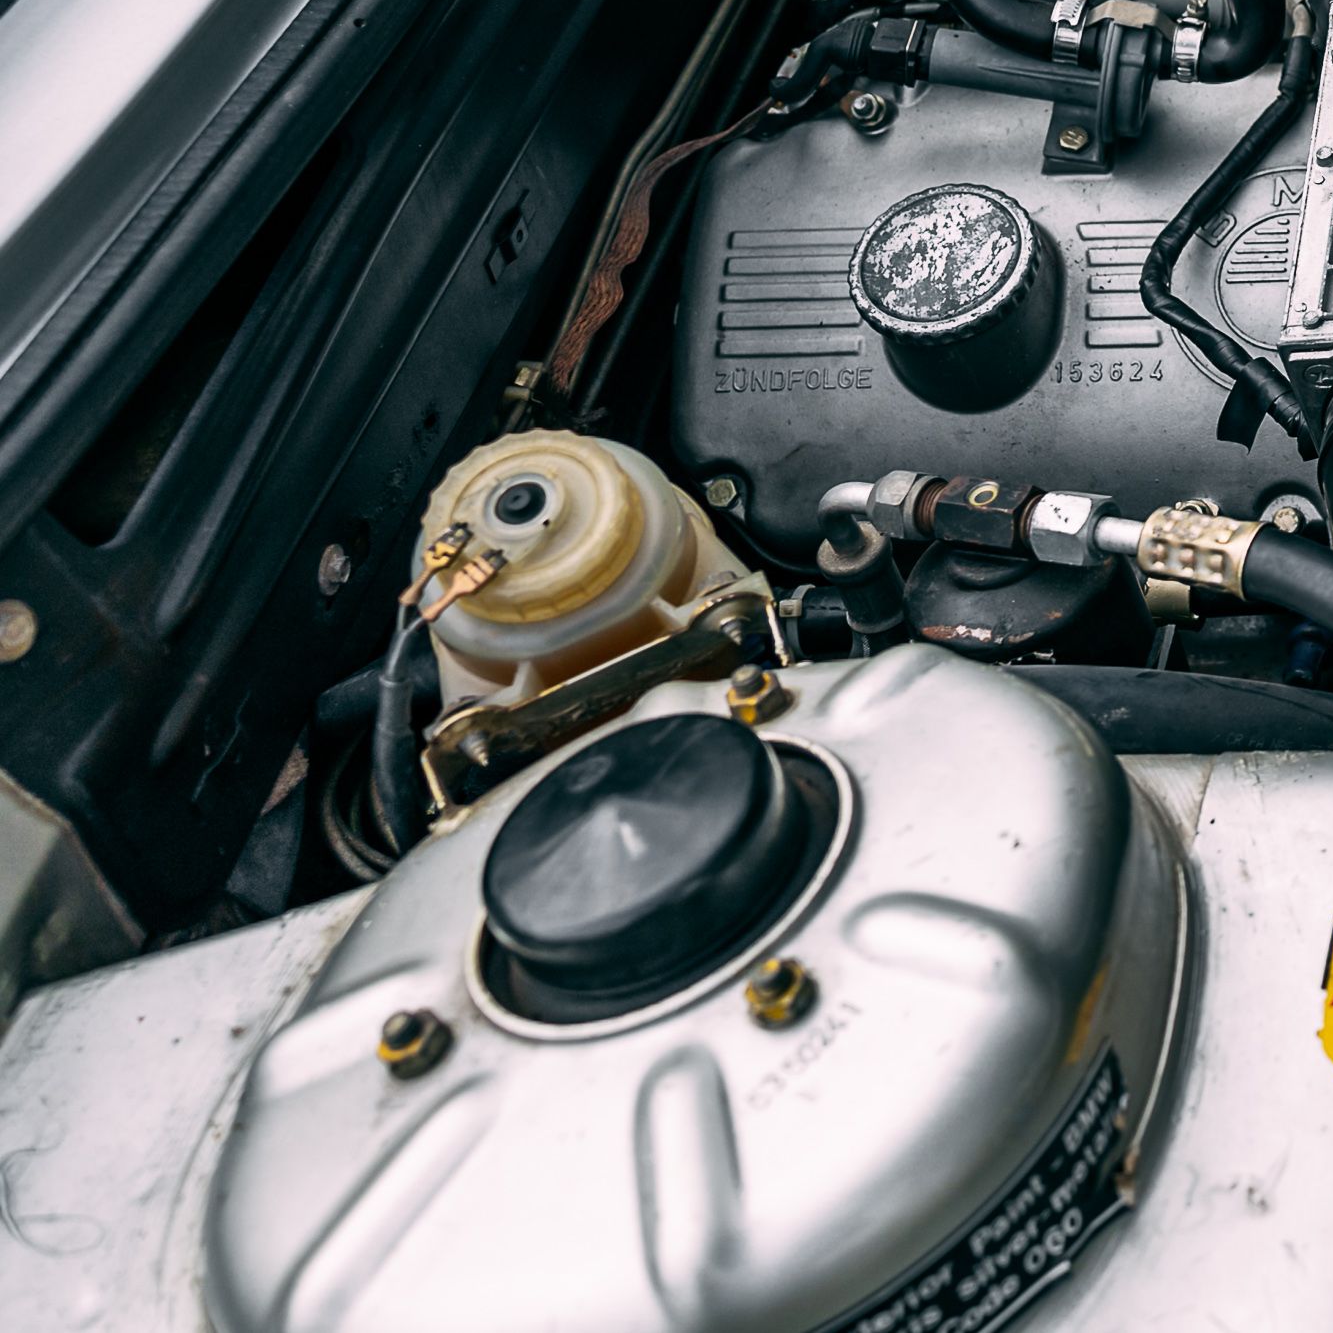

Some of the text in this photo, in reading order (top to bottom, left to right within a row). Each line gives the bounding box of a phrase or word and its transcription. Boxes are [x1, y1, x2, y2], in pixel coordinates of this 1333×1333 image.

[714, 359, 1165, 394] ZÜNDFOLGE 153624
[969, 1172, 1046, 1258] Paint
[1061, 1067, 1114, 1155] BMW
